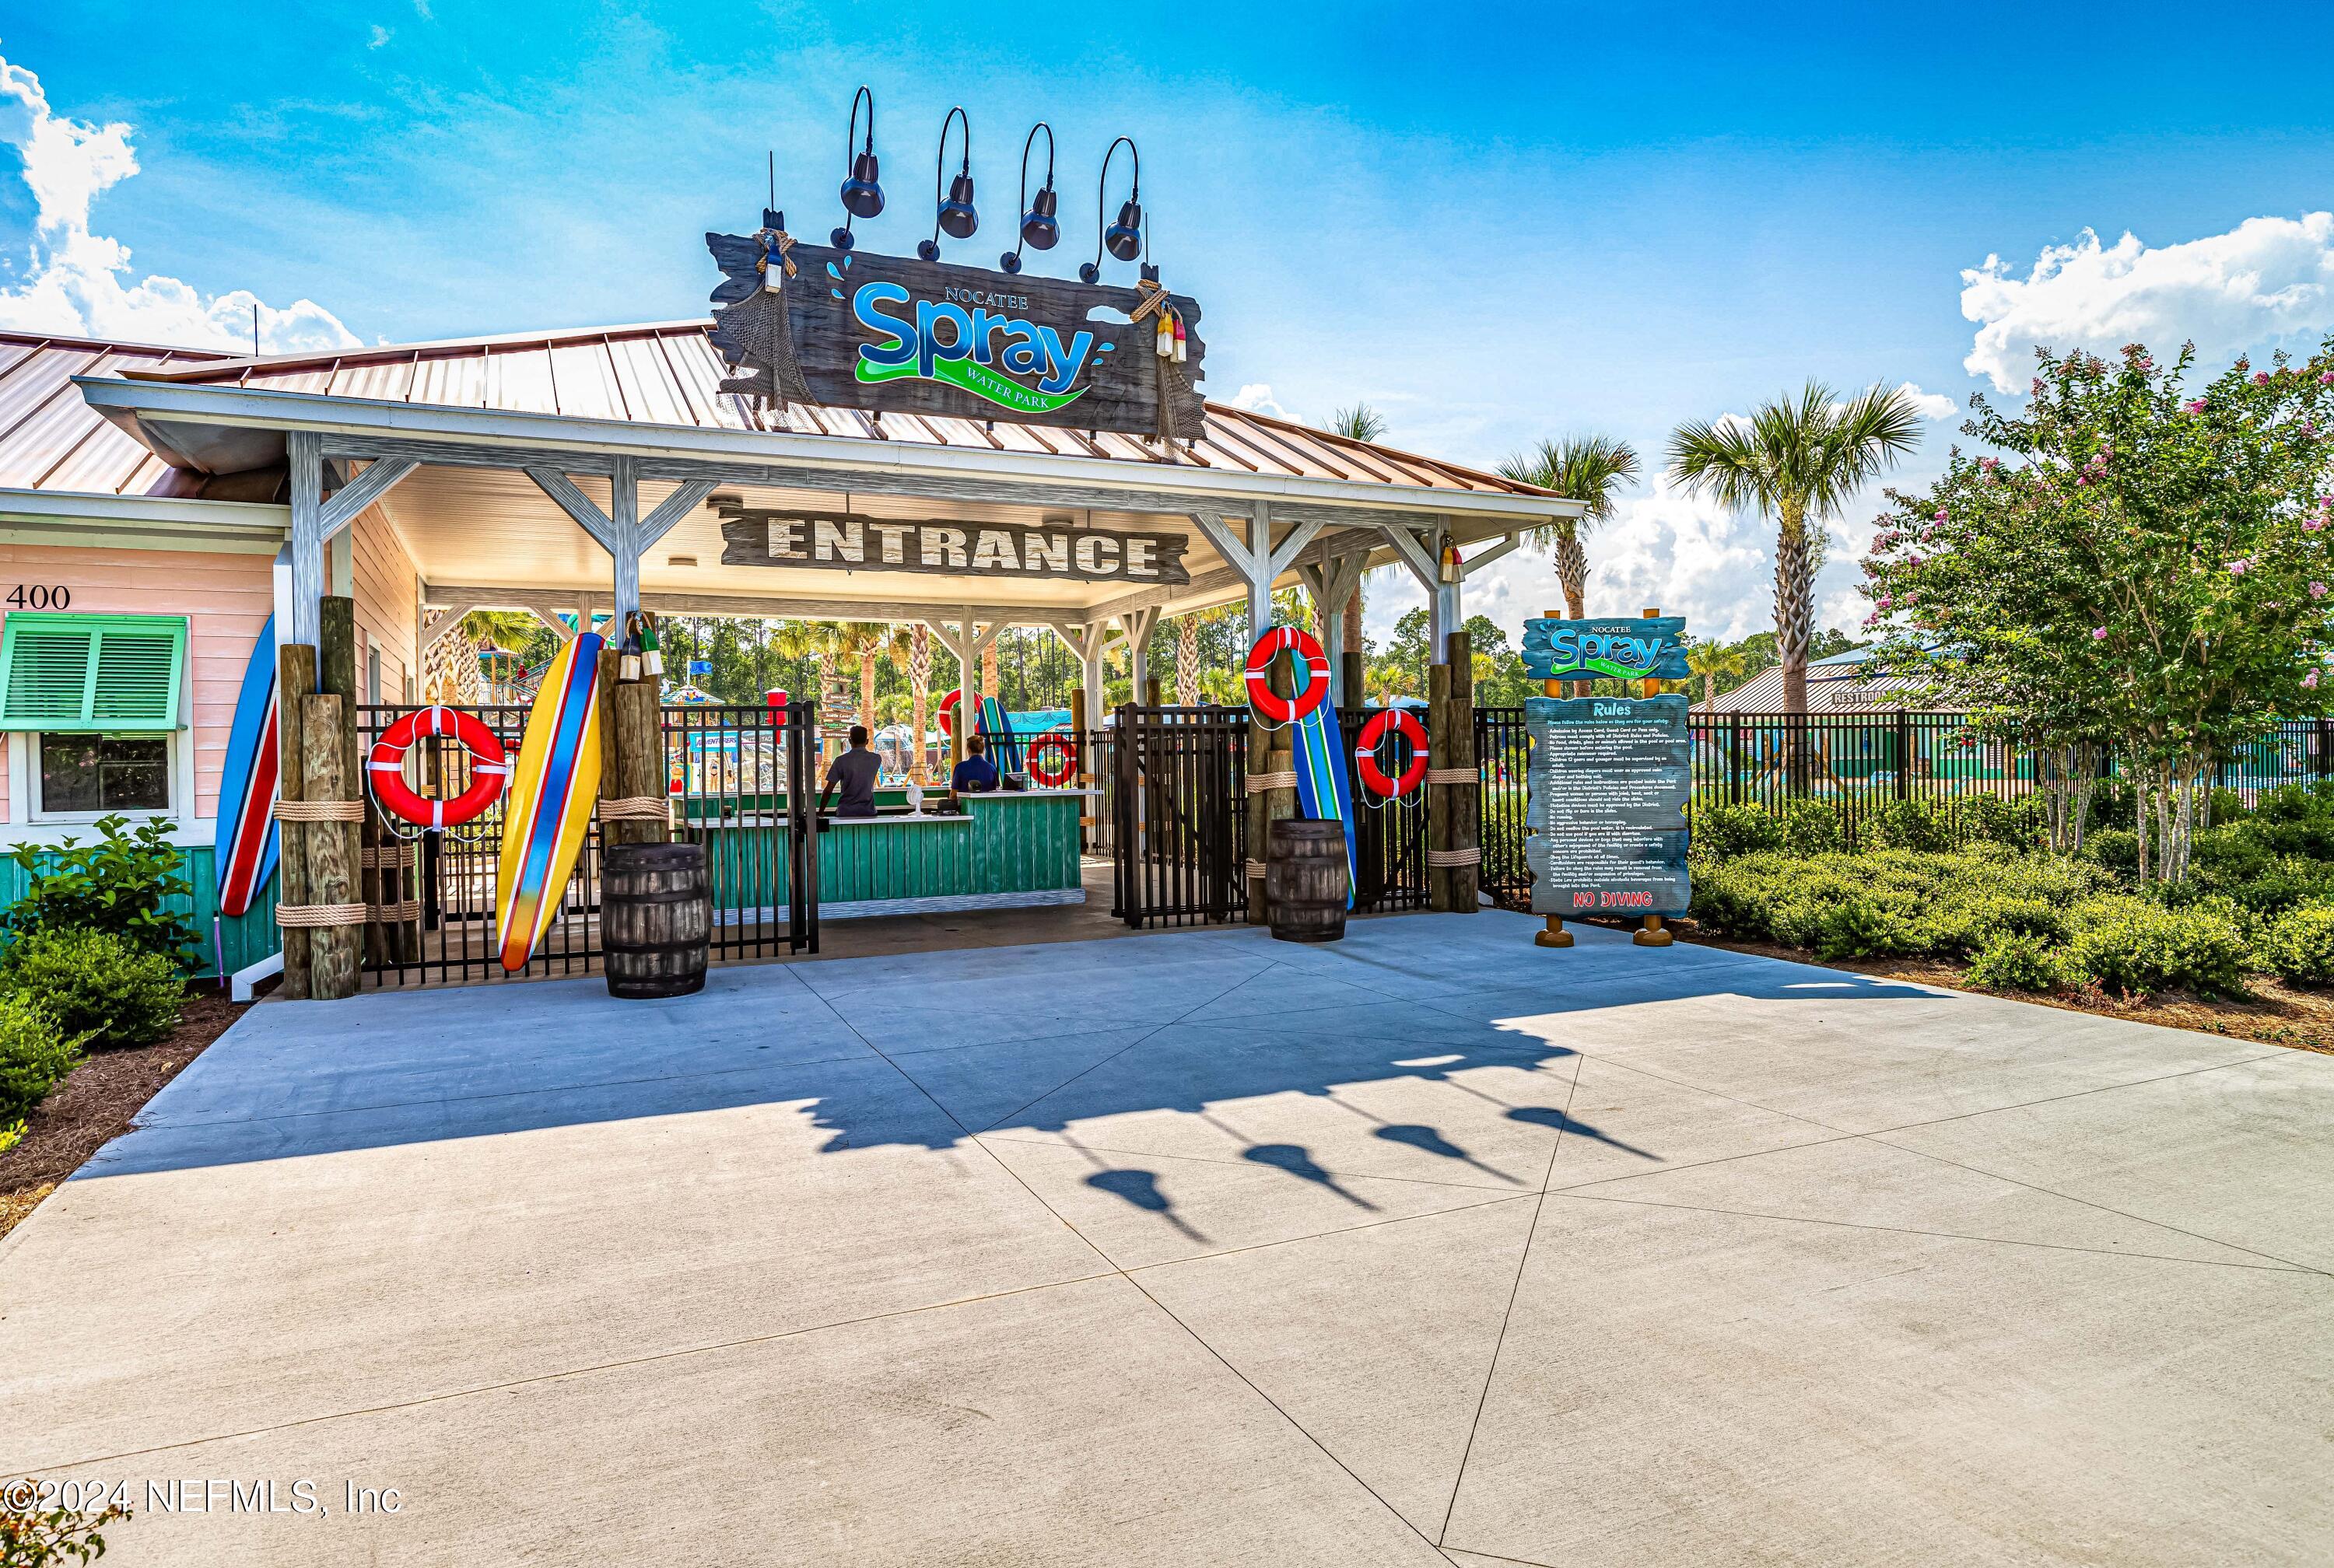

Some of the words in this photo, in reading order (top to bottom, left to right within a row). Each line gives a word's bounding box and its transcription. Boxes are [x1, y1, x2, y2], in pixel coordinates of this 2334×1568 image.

[945, 286, 1029, 310] NOCATEE
[853, 281, 1093, 394] Spray
[968, 367, 1011, 399] WATER
[1015, 392, 1050, 408] PARK
[767, 516, 1159, 576] ENTRANCE
[6, 585, 71, 610] 400
[1551, 628, 1662, 669] Spray
[1600, 661, 1622, 674] WATER
[1835, 690, 1893, 703] RESTROO
[1593, 702, 1631, 716] Rules
[1574, 891, 1595, 907] NO
[1600, 891, 1652, 907] DIVING
